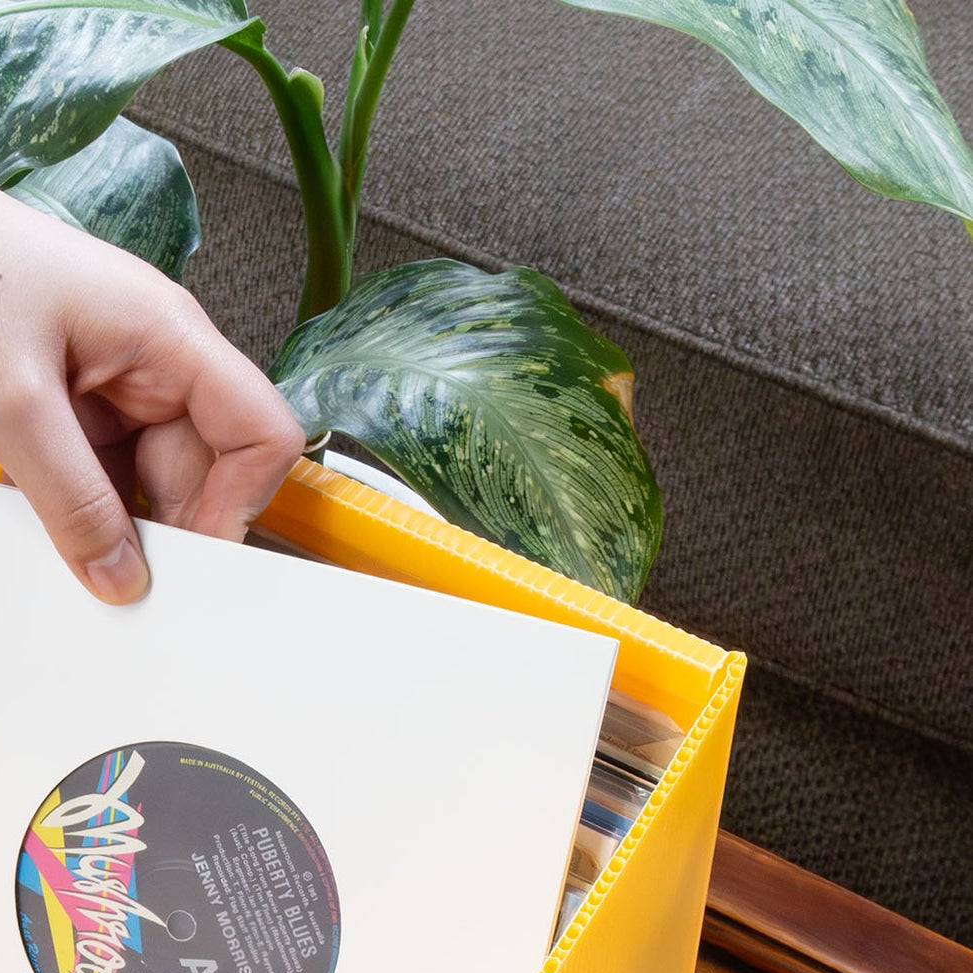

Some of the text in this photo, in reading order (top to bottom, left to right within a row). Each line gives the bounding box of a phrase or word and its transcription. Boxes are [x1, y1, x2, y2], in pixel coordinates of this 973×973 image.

[179, 757, 196, 766] MADE
[205, 761, 235, 777] AUSTRALIA
[235, 771, 244, 780] BY
[244, 775, 268, 794] FESTIVAL
[268, 790, 293, 814] RECORDS
[249, 789, 268, 805] PUBLIC
[190, 850, 223, 908] JENNY
[213, 833, 235, 879] Production:
[236, 823, 251, 844] (Title
[247, 845, 260, 866] Song
[256, 867, 268, 888] From
[275, 914, 292, 945] Puberty
[227, 895, 240, 914] Flag
[239, 852, 256, 882] Comp.)
[252, 883, 265, 902] (Tim
[260, 903, 274, 924] Finn)
[269, 925, 294, 973] (Mushroom)
[252, 826, 293, 902] PUBERTY
[284, 904, 317, 958] BLUES
[275, 830, 295, 872] Mushroom
[307, 909, 325, 945] Australia
